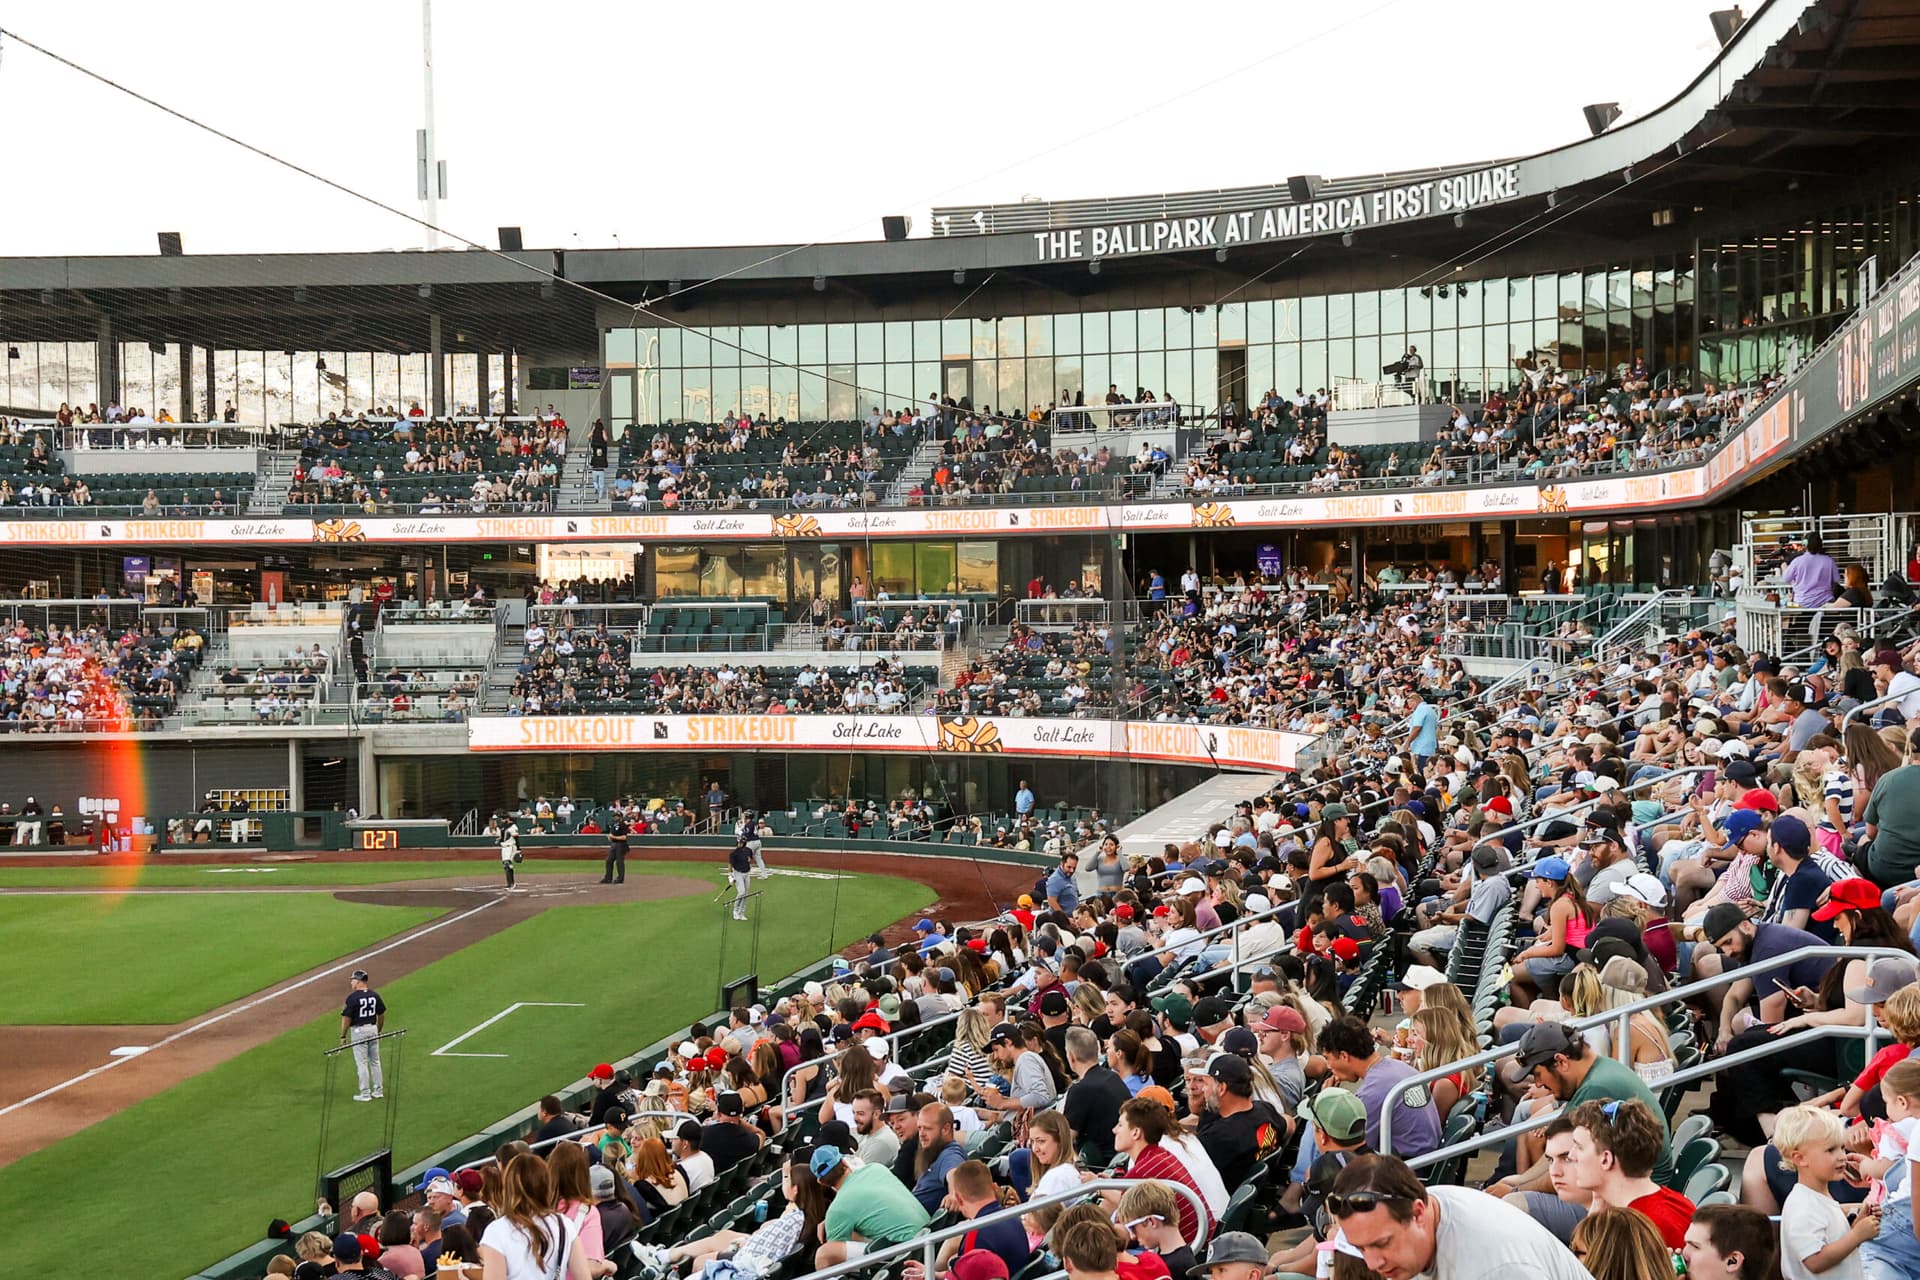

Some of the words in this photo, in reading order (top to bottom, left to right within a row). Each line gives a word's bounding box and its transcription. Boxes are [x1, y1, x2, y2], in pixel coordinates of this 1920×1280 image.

[1034, 228, 1082, 261] THE
[1092, 216, 1217, 258] BALLPARK
[1225, 212, 1255, 244] AT
[1260, 195, 1367, 240] AMERICA
[1372, 182, 1435, 223] FIRST
[1439, 164, 1519, 208] SQUARE
[1325, 497, 1384, 518] STRIKEOUT
[1412, 492, 1468, 514] STRIKEOUT
[1483, 493, 1499, 507] Salt
[1500, 493, 1519, 506] Lake
[1029, 508, 1100, 527] STRIKEOUT
[1123, 510, 1144, 521] Salt
[1144, 510, 1169, 520] Lake
[1257, 505, 1278, 516] Salt
[1279, 503, 1304, 516] Lake
[125, 521, 205, 538] STRIKEOUT
[231, 524, 254, 535] Salt
[254, 525, 285, 535] Lake
[392, 522, 416, 534] Salt
[417, 523, 446, 533] Lake
[476, 518, 555, 536] STRIKEOUT
[591, 517, 669, 534] STRIKEOUT
[693, 519, 715, 531] Salt
[715, 519, 745, 530] Lake
[847, 516, 868, 528] Salt
[870, 516, 897, 527] Lake
[925, 511, 999, 530] STRIKEOUT
[8, 523, 87, 540] STRIKEOUT
[520, 719, 635, 744] STRIKEOUT
[687, 717, 797, 742] STRIKEOUT
[833, 722, 864, 740] Salt
[864, 723, 903, 740] Lake
[1033, 725, 1061, 743] Salt
[1061, 726, 1095, 743] Lake
[1124, 723, 1198, 755] STRIKEOUT
[1227, 729, 1281, 762] STRIKEOUT
[363, 830, 397, 850] 027
[359, 997, 377, 1018] 23
[619, 1111, 627, 1122] P
[406, 1182, 414, 1195] 116
[326, 1221, 335, 1234] 117
